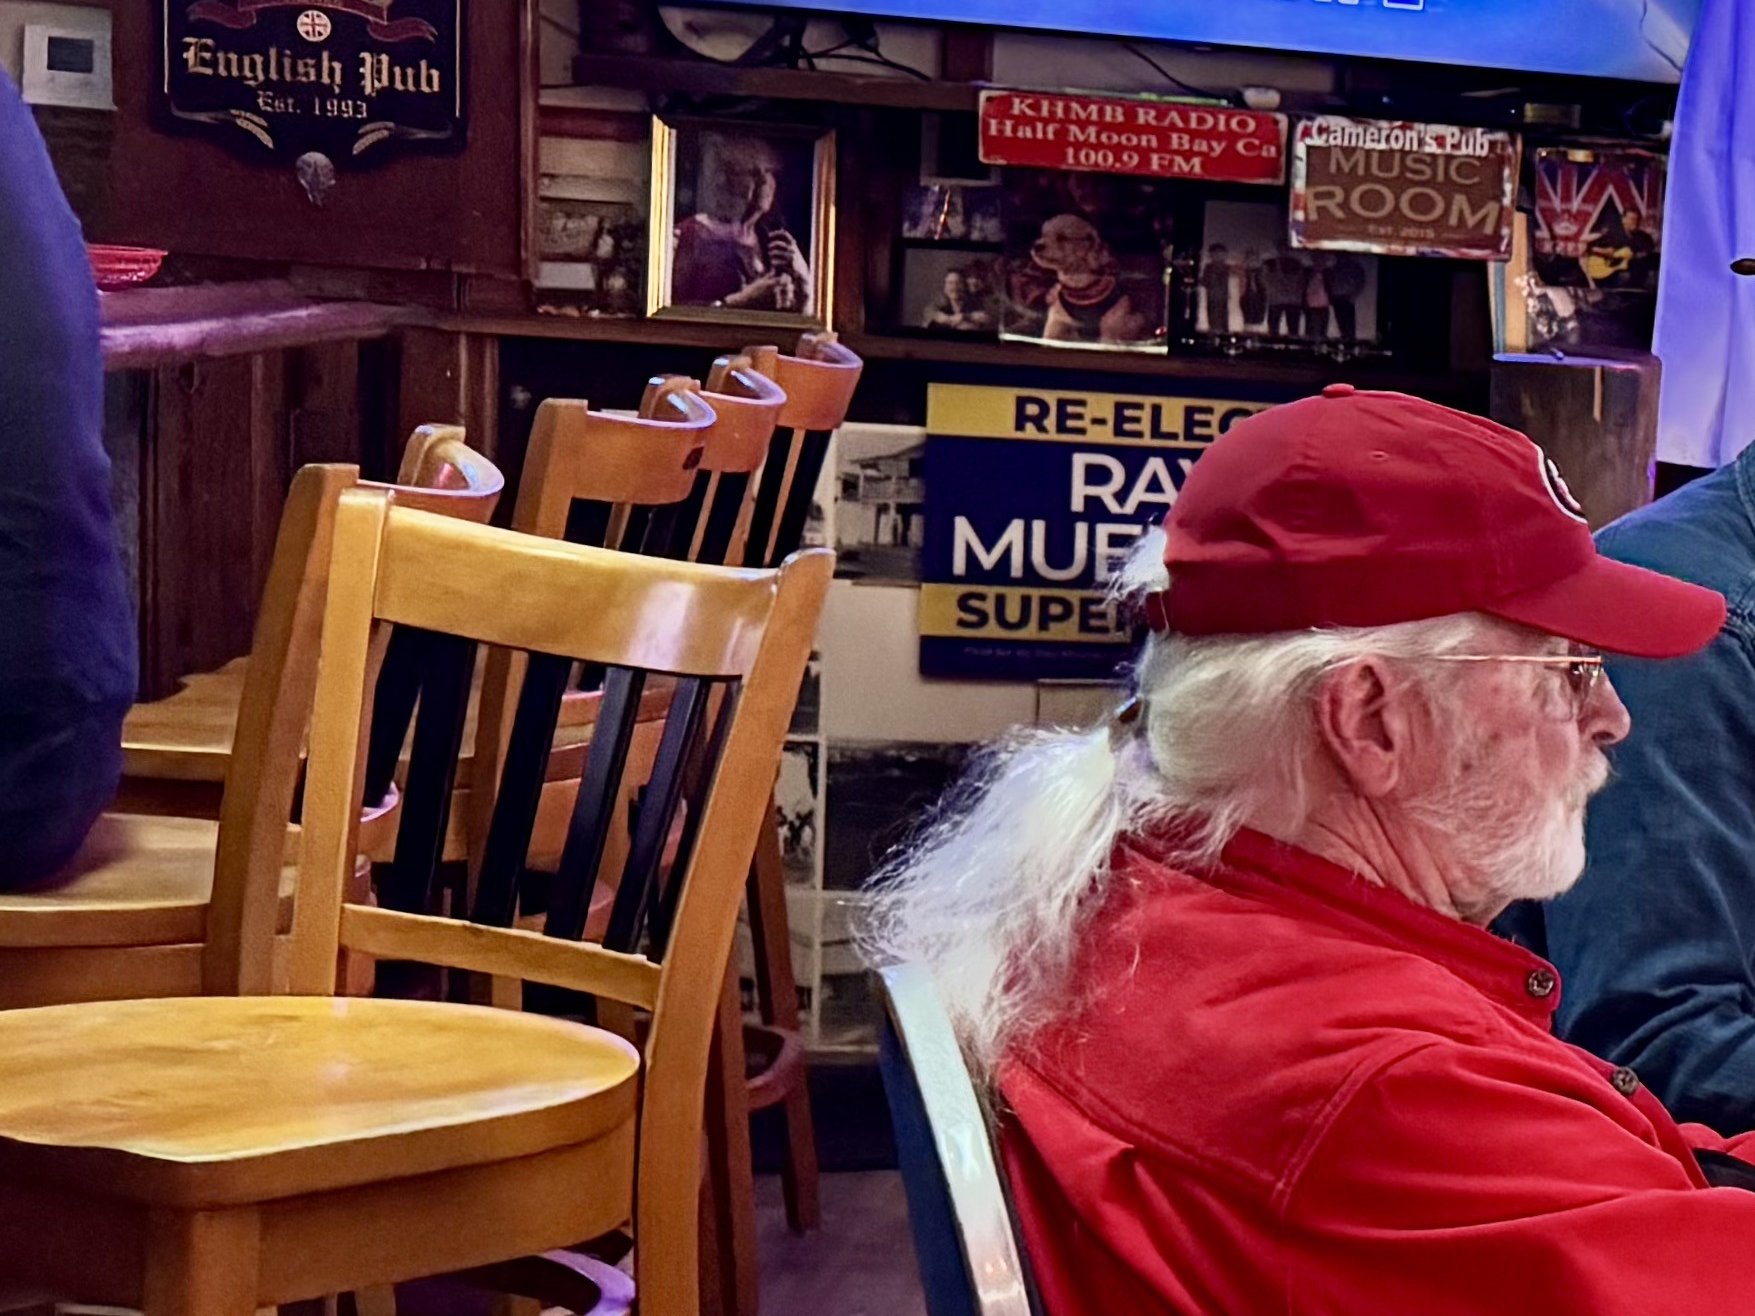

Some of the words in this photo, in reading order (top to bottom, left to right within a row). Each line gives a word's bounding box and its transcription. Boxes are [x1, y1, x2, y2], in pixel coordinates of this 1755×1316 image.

[182, 35, 343, 94] English
[358, 51, 441, 97] Pub
[313, 95, 369, 118] 1993
[1009, 95, 1127, 128] KHMB
[1136, 102, 1259, 135] RADIO
[987, 117, 1061, 144] Half
[1083, 124, 1160, 151] Moon
[1168, 131, 1228, 159] Bay
[1234, 136, 1278, 161] Ca
[1310, 119, 1438, 153] Cameron's
[1442, 125, 1491, 159] Pub
[1063, 145, 1141, 171] 100.9
[1148, 150, 1204, 177] FM
[1327, 148, 1481, 186] MUSIC
[1306, 184, 1499, 238] ROOM
[956, 591, 1128, 634] SUPE
